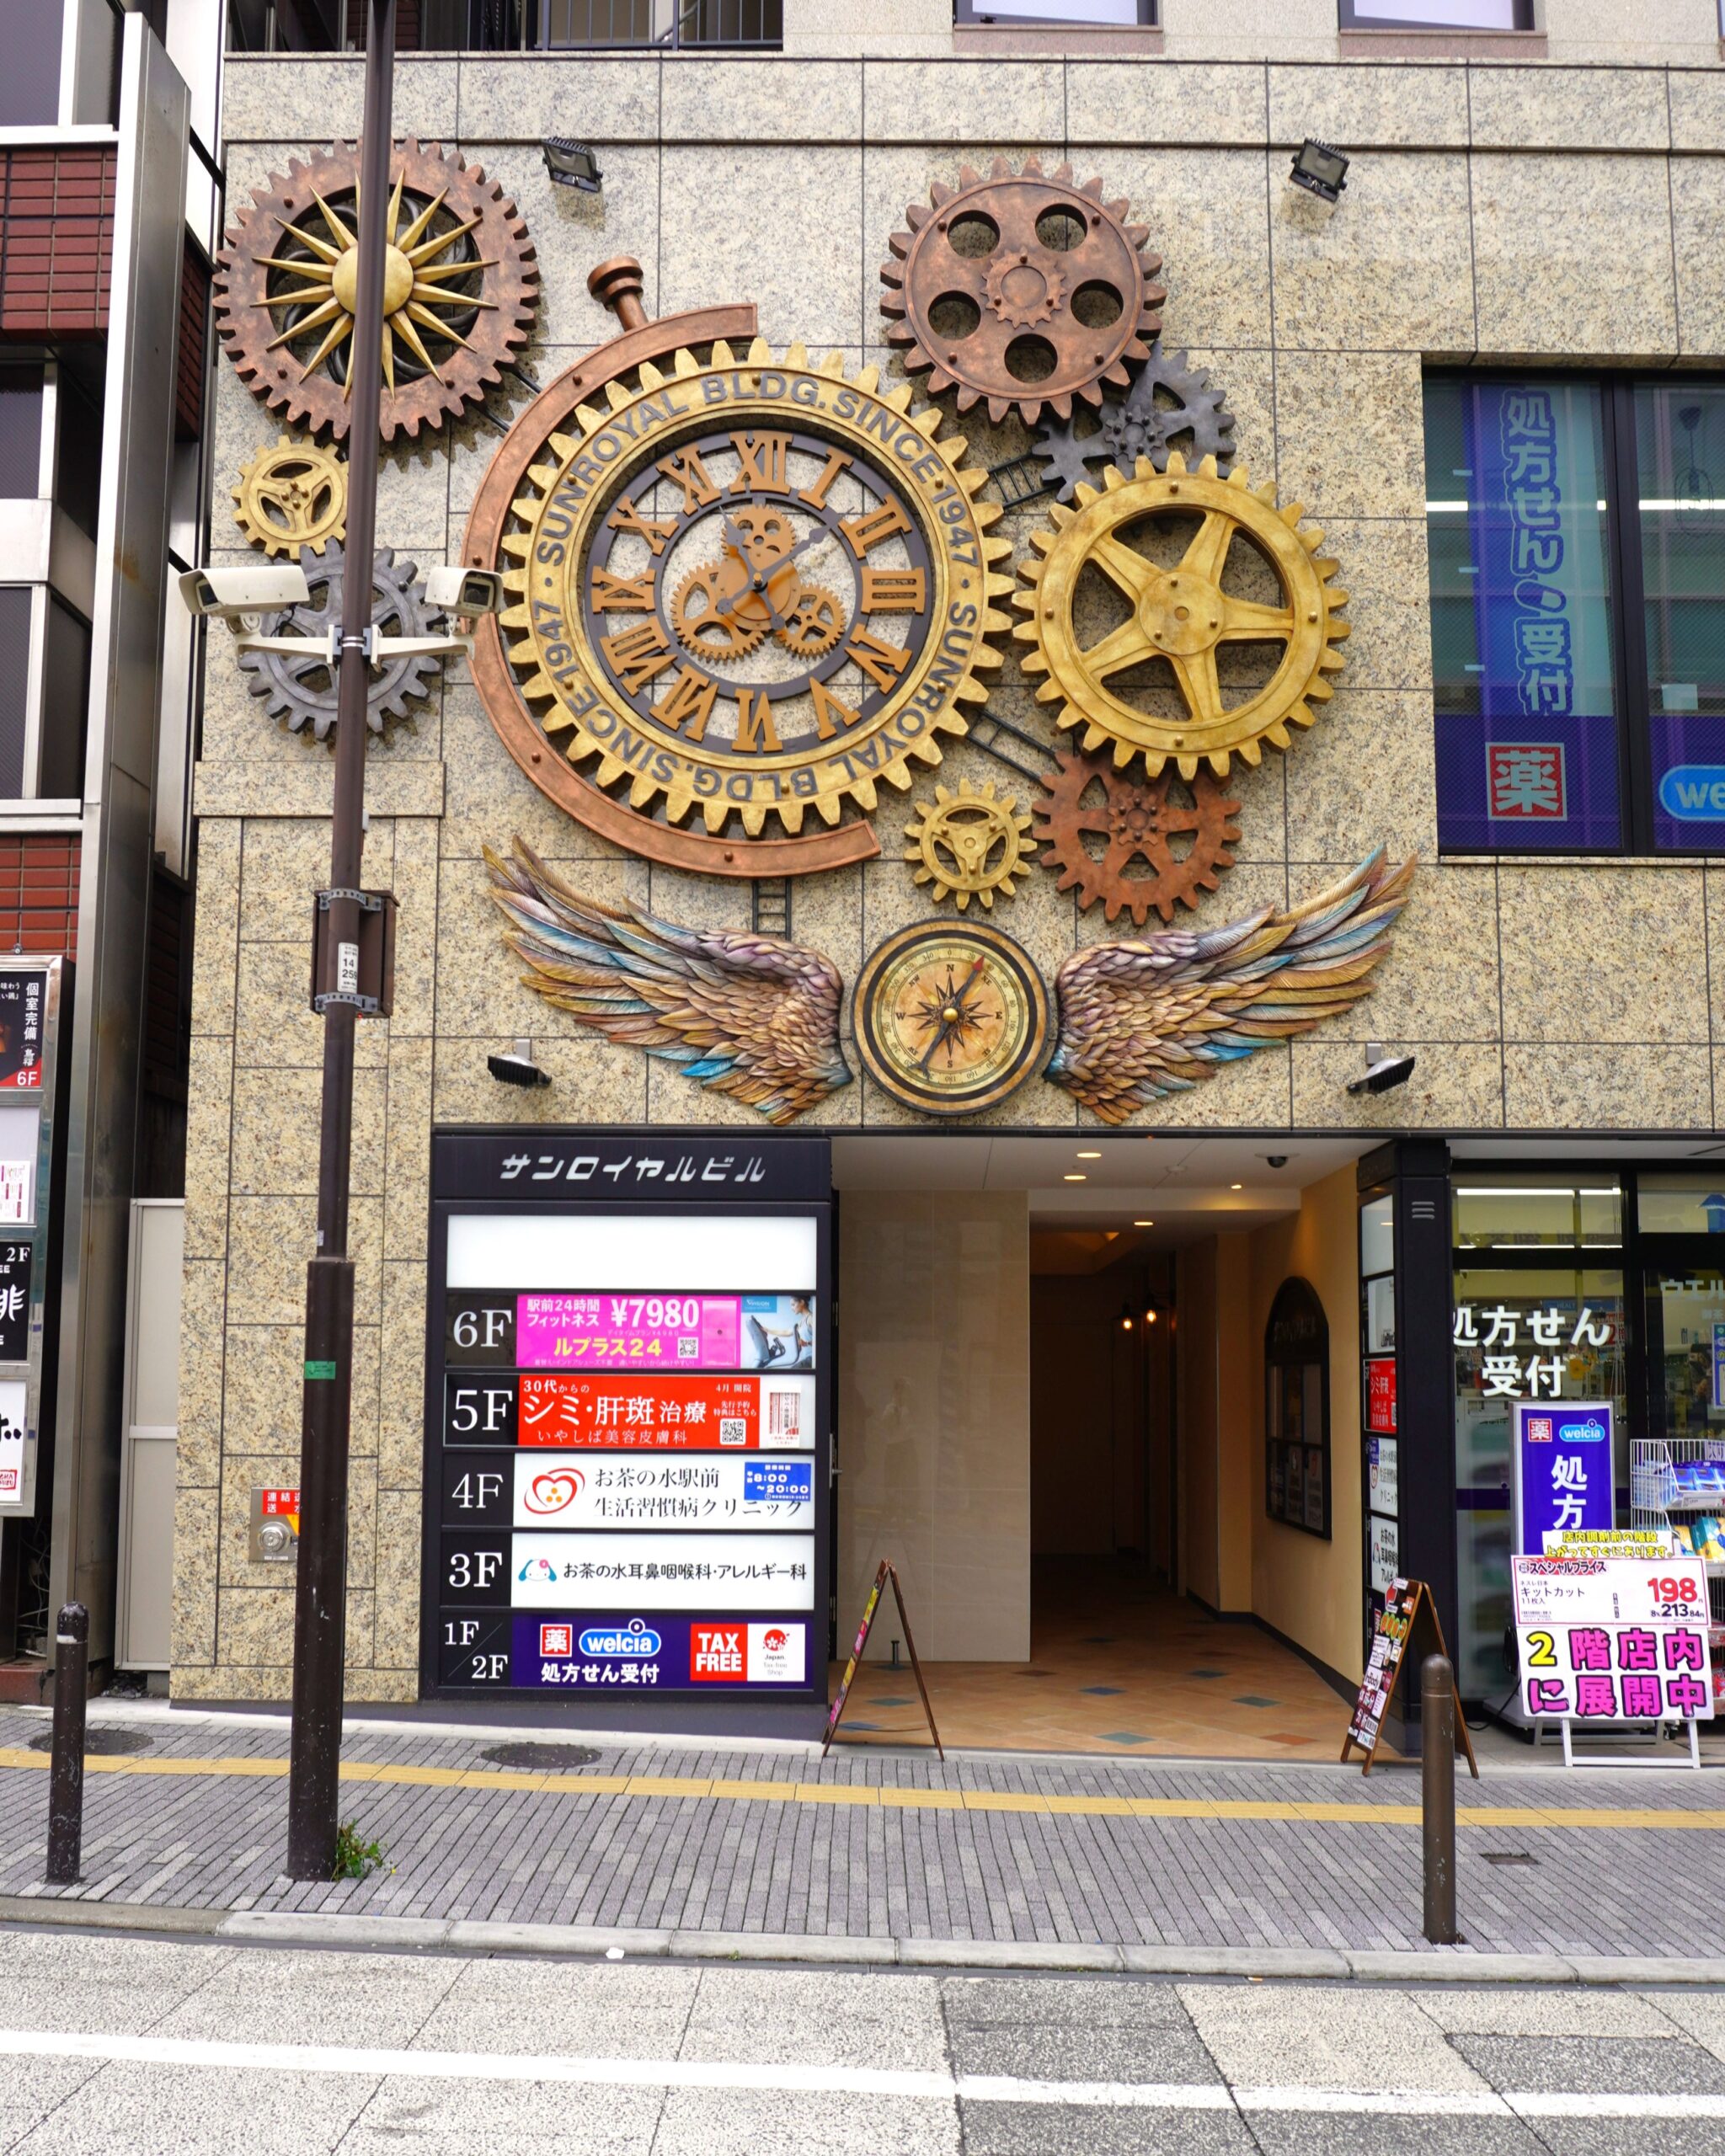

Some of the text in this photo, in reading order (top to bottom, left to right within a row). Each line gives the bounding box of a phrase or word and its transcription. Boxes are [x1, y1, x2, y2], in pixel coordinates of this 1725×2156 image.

[729, 431, 794, 495] XII
[798, 446, 853, 510] I
[537, 390, 690, 567] SUNROYAL
[832, 390, 944, 483] SINCE
[931, 485, 980, 568] 1947
[655, 444, 722, 516] XI
[607, 495, 679, 556] X
[838, 493, 912, 559] II
[1506, 394, 1568, 713] 処方せん 受付
[591, 566, 656, 614] IX
[861, 566, 926, 615] III
[533, 600, 579, 683] 1947
[599, 616, 677, 696] VIII
[843, 623, 912, 695] IV
[649, 664, 718, 742] VII
[828, 601, 977, 780] SUNROYAL
[732, 688, 783, 752] VI
[809, 677, 862, 742] V
[567, 686, 681, 782] SINCE
[1494, 750, 1560, 814] 薬
[344, 958, 354, 967] 14
[24, 982, 40, 1040] 個室完備
[895, 1012, 907, 1021] W
[996, 1011, 1003, 1020] E
[17, 1071, 38, 1086] 6F
[947, 1059, 953, 1068] S
[500, 1155, 766, 1182] サンロイヤルビル
[6, 1247, 30, 1262] 2F
[526, 1299, 600, 1312] 駅前24時間
[527, 1313, 599, 1327] フィットネス
[611, 1299, 699, 1328] ¥7980
[453, 1310, 512, 1347] 6F
[553, 1337, 662, 1357] ルプラス24
[523, 1380, 590, 1394] 30代からの
[1482, 1354, 1567, 1398] 受付
[452, 1390, 513, 1431] 5F
[537, 1429, 687, 1444] いやしば美容皮膚科
[1530, 1421, 1601, 1440] 薬 welcia
[451, 1474, 504, 1508] 4F
[595, 1467, 719, 1488] お茶の水駅前
[1551, 1454, 1588, 1529] 処方
[594, 1497, 802, 1518] 生活習慣病クリニック
[1544, 1545, 1674, 1558] 上がってすぐにあります。
[449, 1551, 502, 1588] 3F
[563, 1562, 807, 1580] お茶の水耳鼻咽喉科・アレルギー科
[1530, 1561, 1606, 1574] スペシャルプライス
[1521, 1587, 1584, 1598] キットカット
[1648, 1577, 1697, 1603] 198
[445, 1621, 479, 1645] 1F
[544, 1629, 652, 1653] 薬 welcia
[698, 1632, 739, 1652] TAX
[1526, 1627, 1705, 1670] 2階店内
[472, 1655, 508, 1679] 2F
[541, 1662, 660, 1684] 処方せん受付
[696, 1653, 742, 1672] FREE
[1527, 1673, 1706, 1719] に展開中
